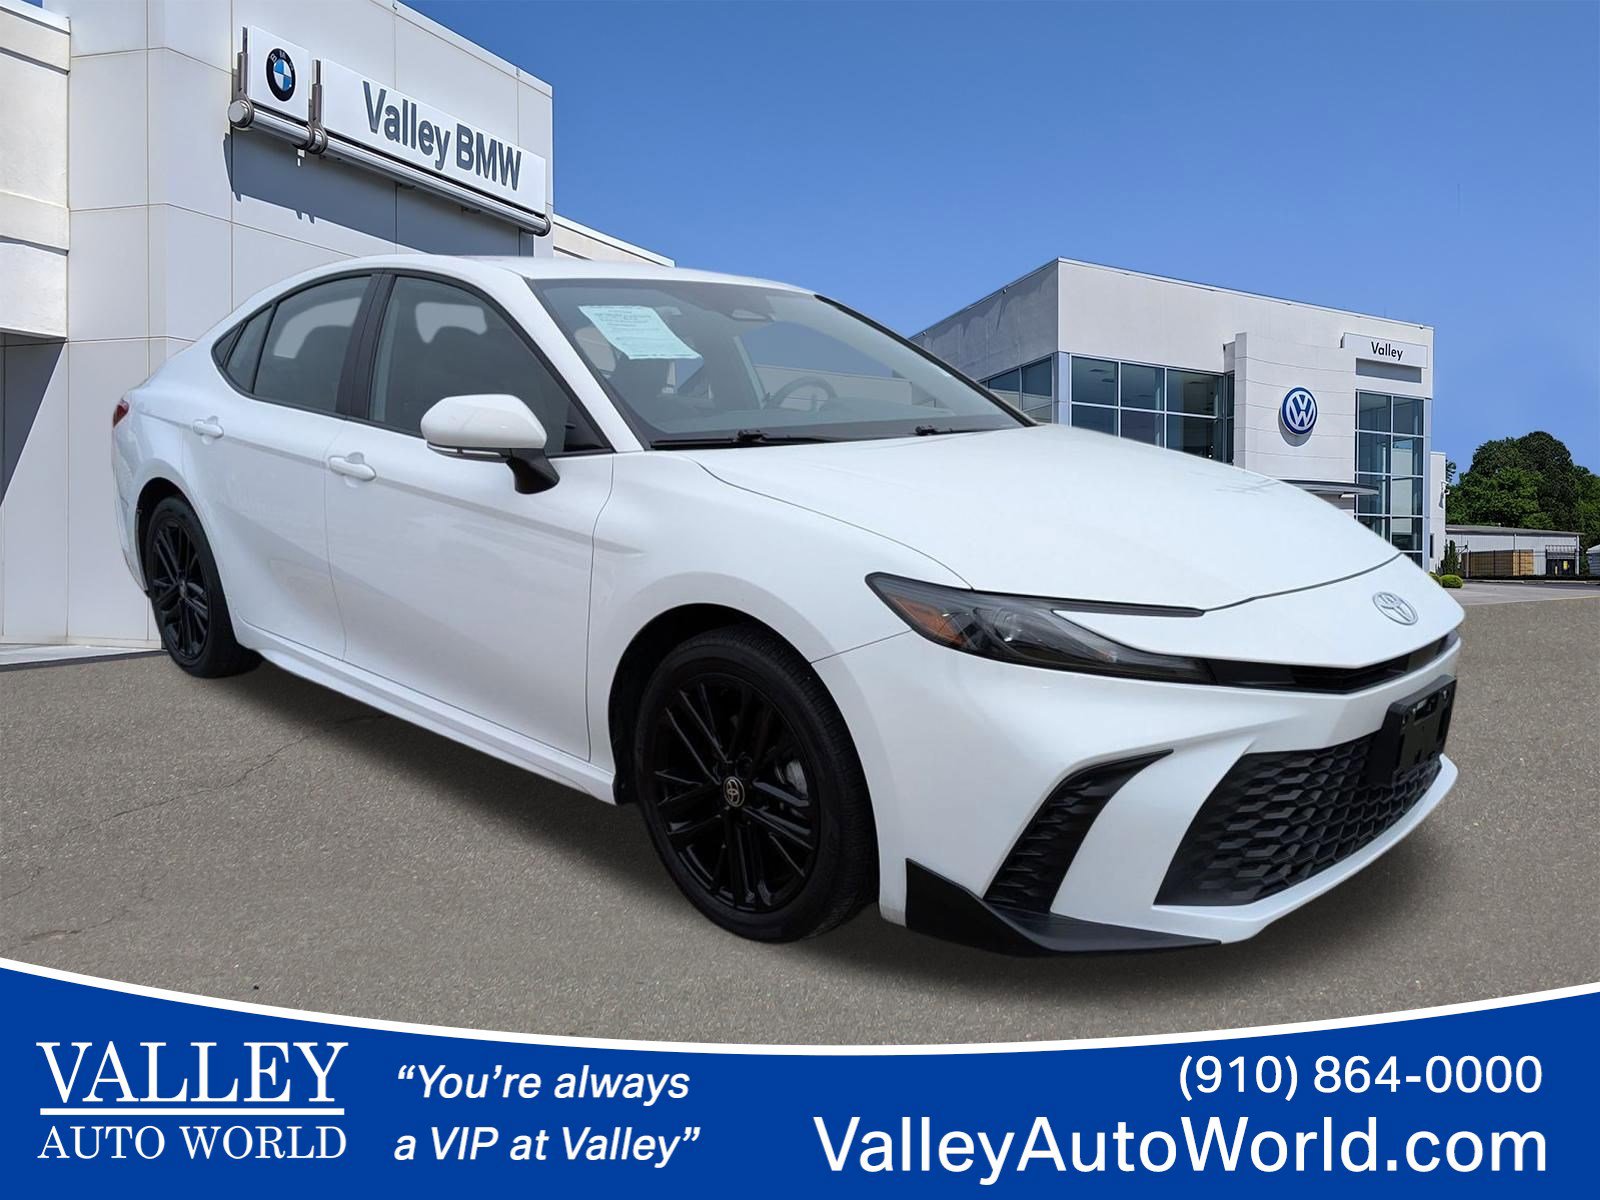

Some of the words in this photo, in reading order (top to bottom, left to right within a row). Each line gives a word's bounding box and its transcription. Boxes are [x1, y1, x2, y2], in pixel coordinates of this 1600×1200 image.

[362, 80, 451, 171] Valley
[456, 123, 522, 191] BMW
[1371, 341, 1403, 361] Valley
